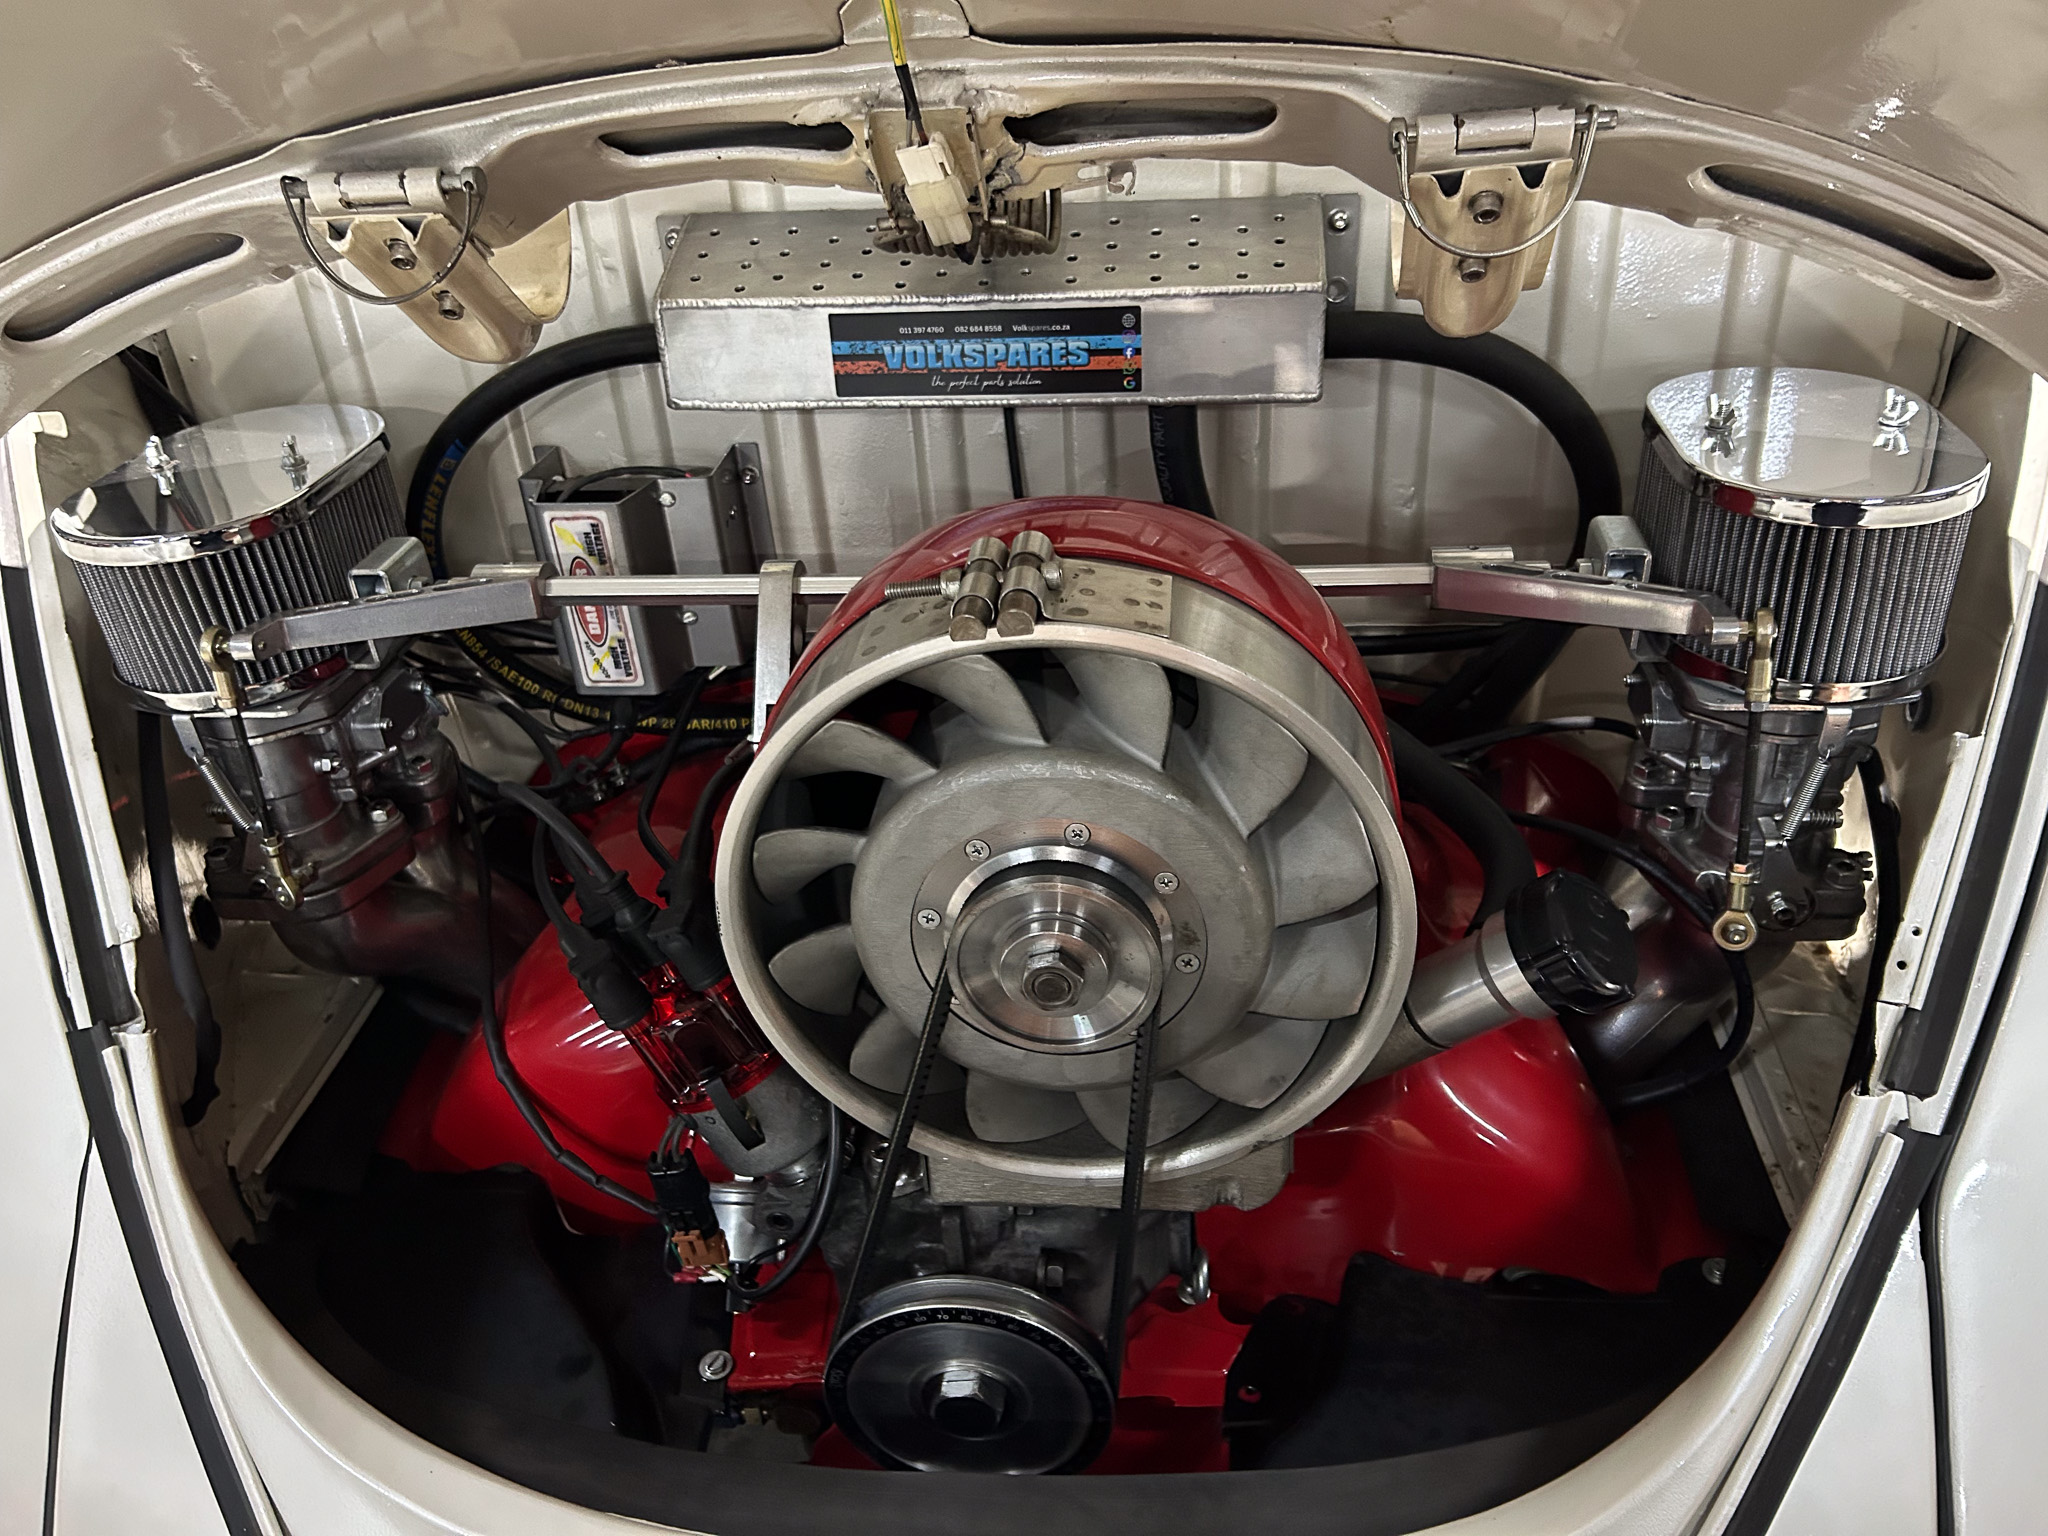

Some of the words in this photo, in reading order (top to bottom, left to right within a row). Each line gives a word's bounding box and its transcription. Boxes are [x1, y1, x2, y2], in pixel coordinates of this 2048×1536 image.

[899, 327, 912, 335] 011
[913, 326, 926, 334] 397
[926, 326, 945, 334] 4760
[954, 325, 968, 333] 082
[969, 325, 983, 333] 684
[984, 324, 1002, 333] 8558
[1012, 324, 1071, 332] Volkspares.co.za
[882, 340, 1091, 370] VOLKSPARES
[931, 374, 945, 387] the
[947, 374, 980, 392] perfect
[980, 373, 1005, 391] parts
[1007, 373, 1042, 387] solution
[583, 532, 597, 556] HIGH
[590, 523, 608, 566] VOLTAGE
[609, 647, 623, 670] HIGH
[617, 638, 634, 678] VOLTAGE
[686, 718, 737, 730] AR/410
